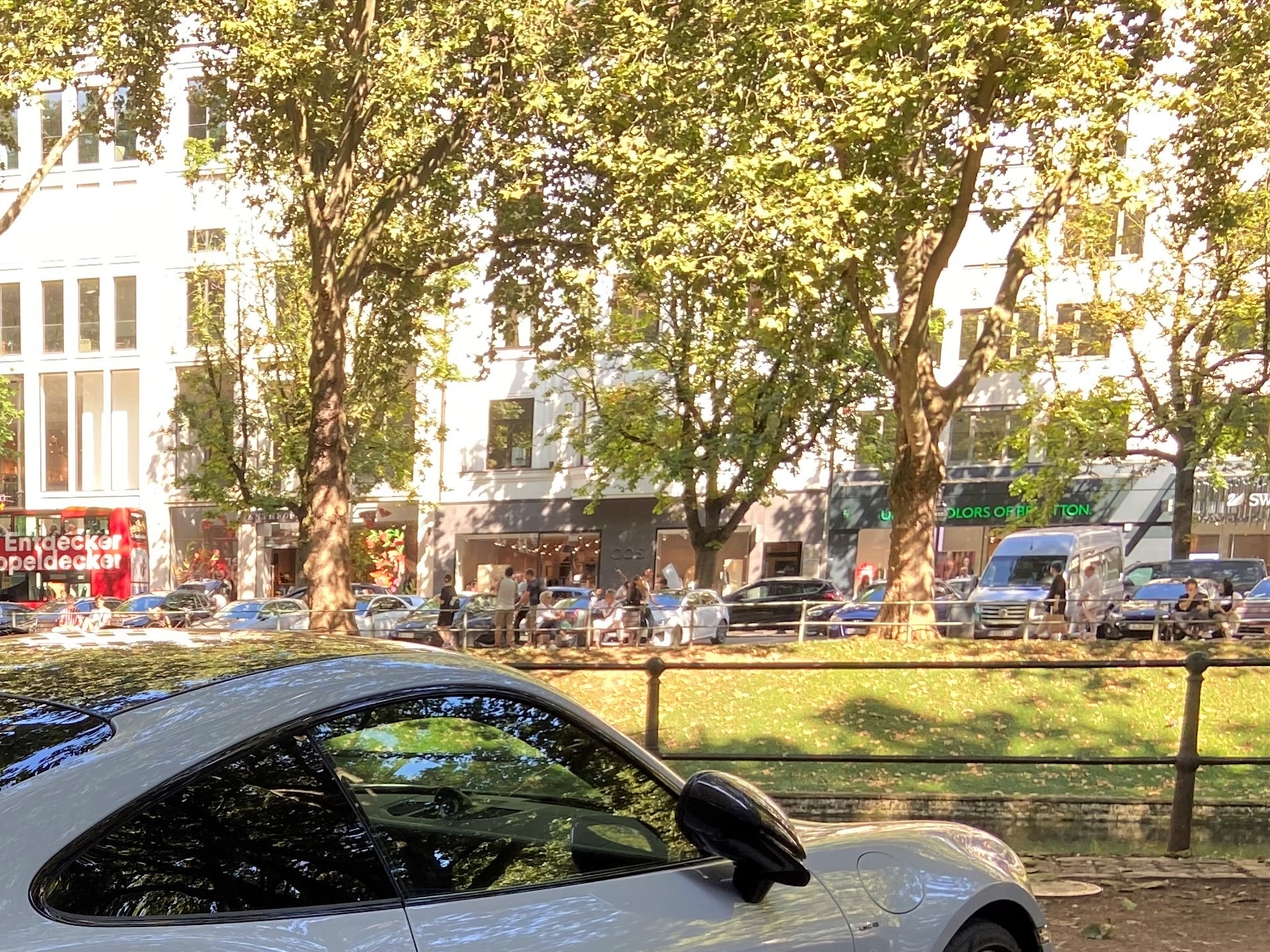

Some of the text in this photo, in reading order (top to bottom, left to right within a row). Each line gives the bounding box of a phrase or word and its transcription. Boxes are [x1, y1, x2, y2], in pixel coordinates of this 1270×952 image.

[946, 504, 1092, 519] OLORS OF BETTON.
[5, 532, 123, 552] Entdecker
[611, 548, 645, 560] COS
